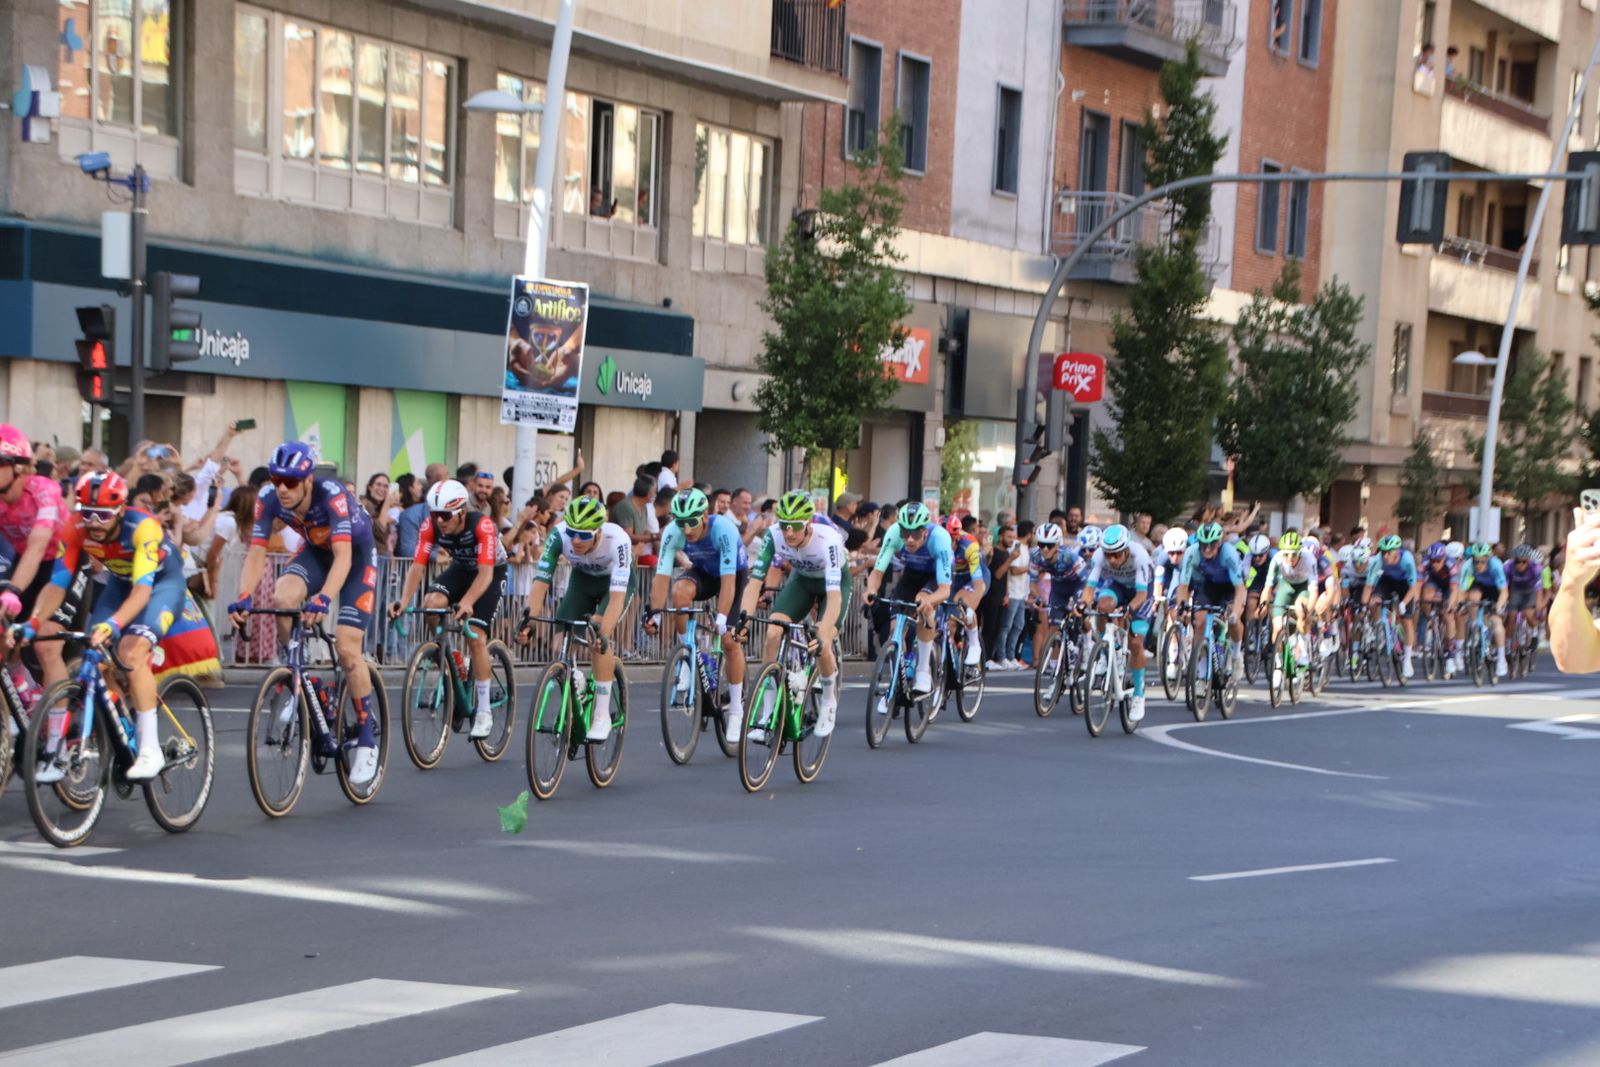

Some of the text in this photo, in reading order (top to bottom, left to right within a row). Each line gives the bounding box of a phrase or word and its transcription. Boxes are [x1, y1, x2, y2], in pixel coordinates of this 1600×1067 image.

[195, 328, 250, 367] Unicaja
[1061, 360, 1096, 375] Prima
[616, 371, 652, 400] Unicaja
[617, 545, 625, 568] RGA
